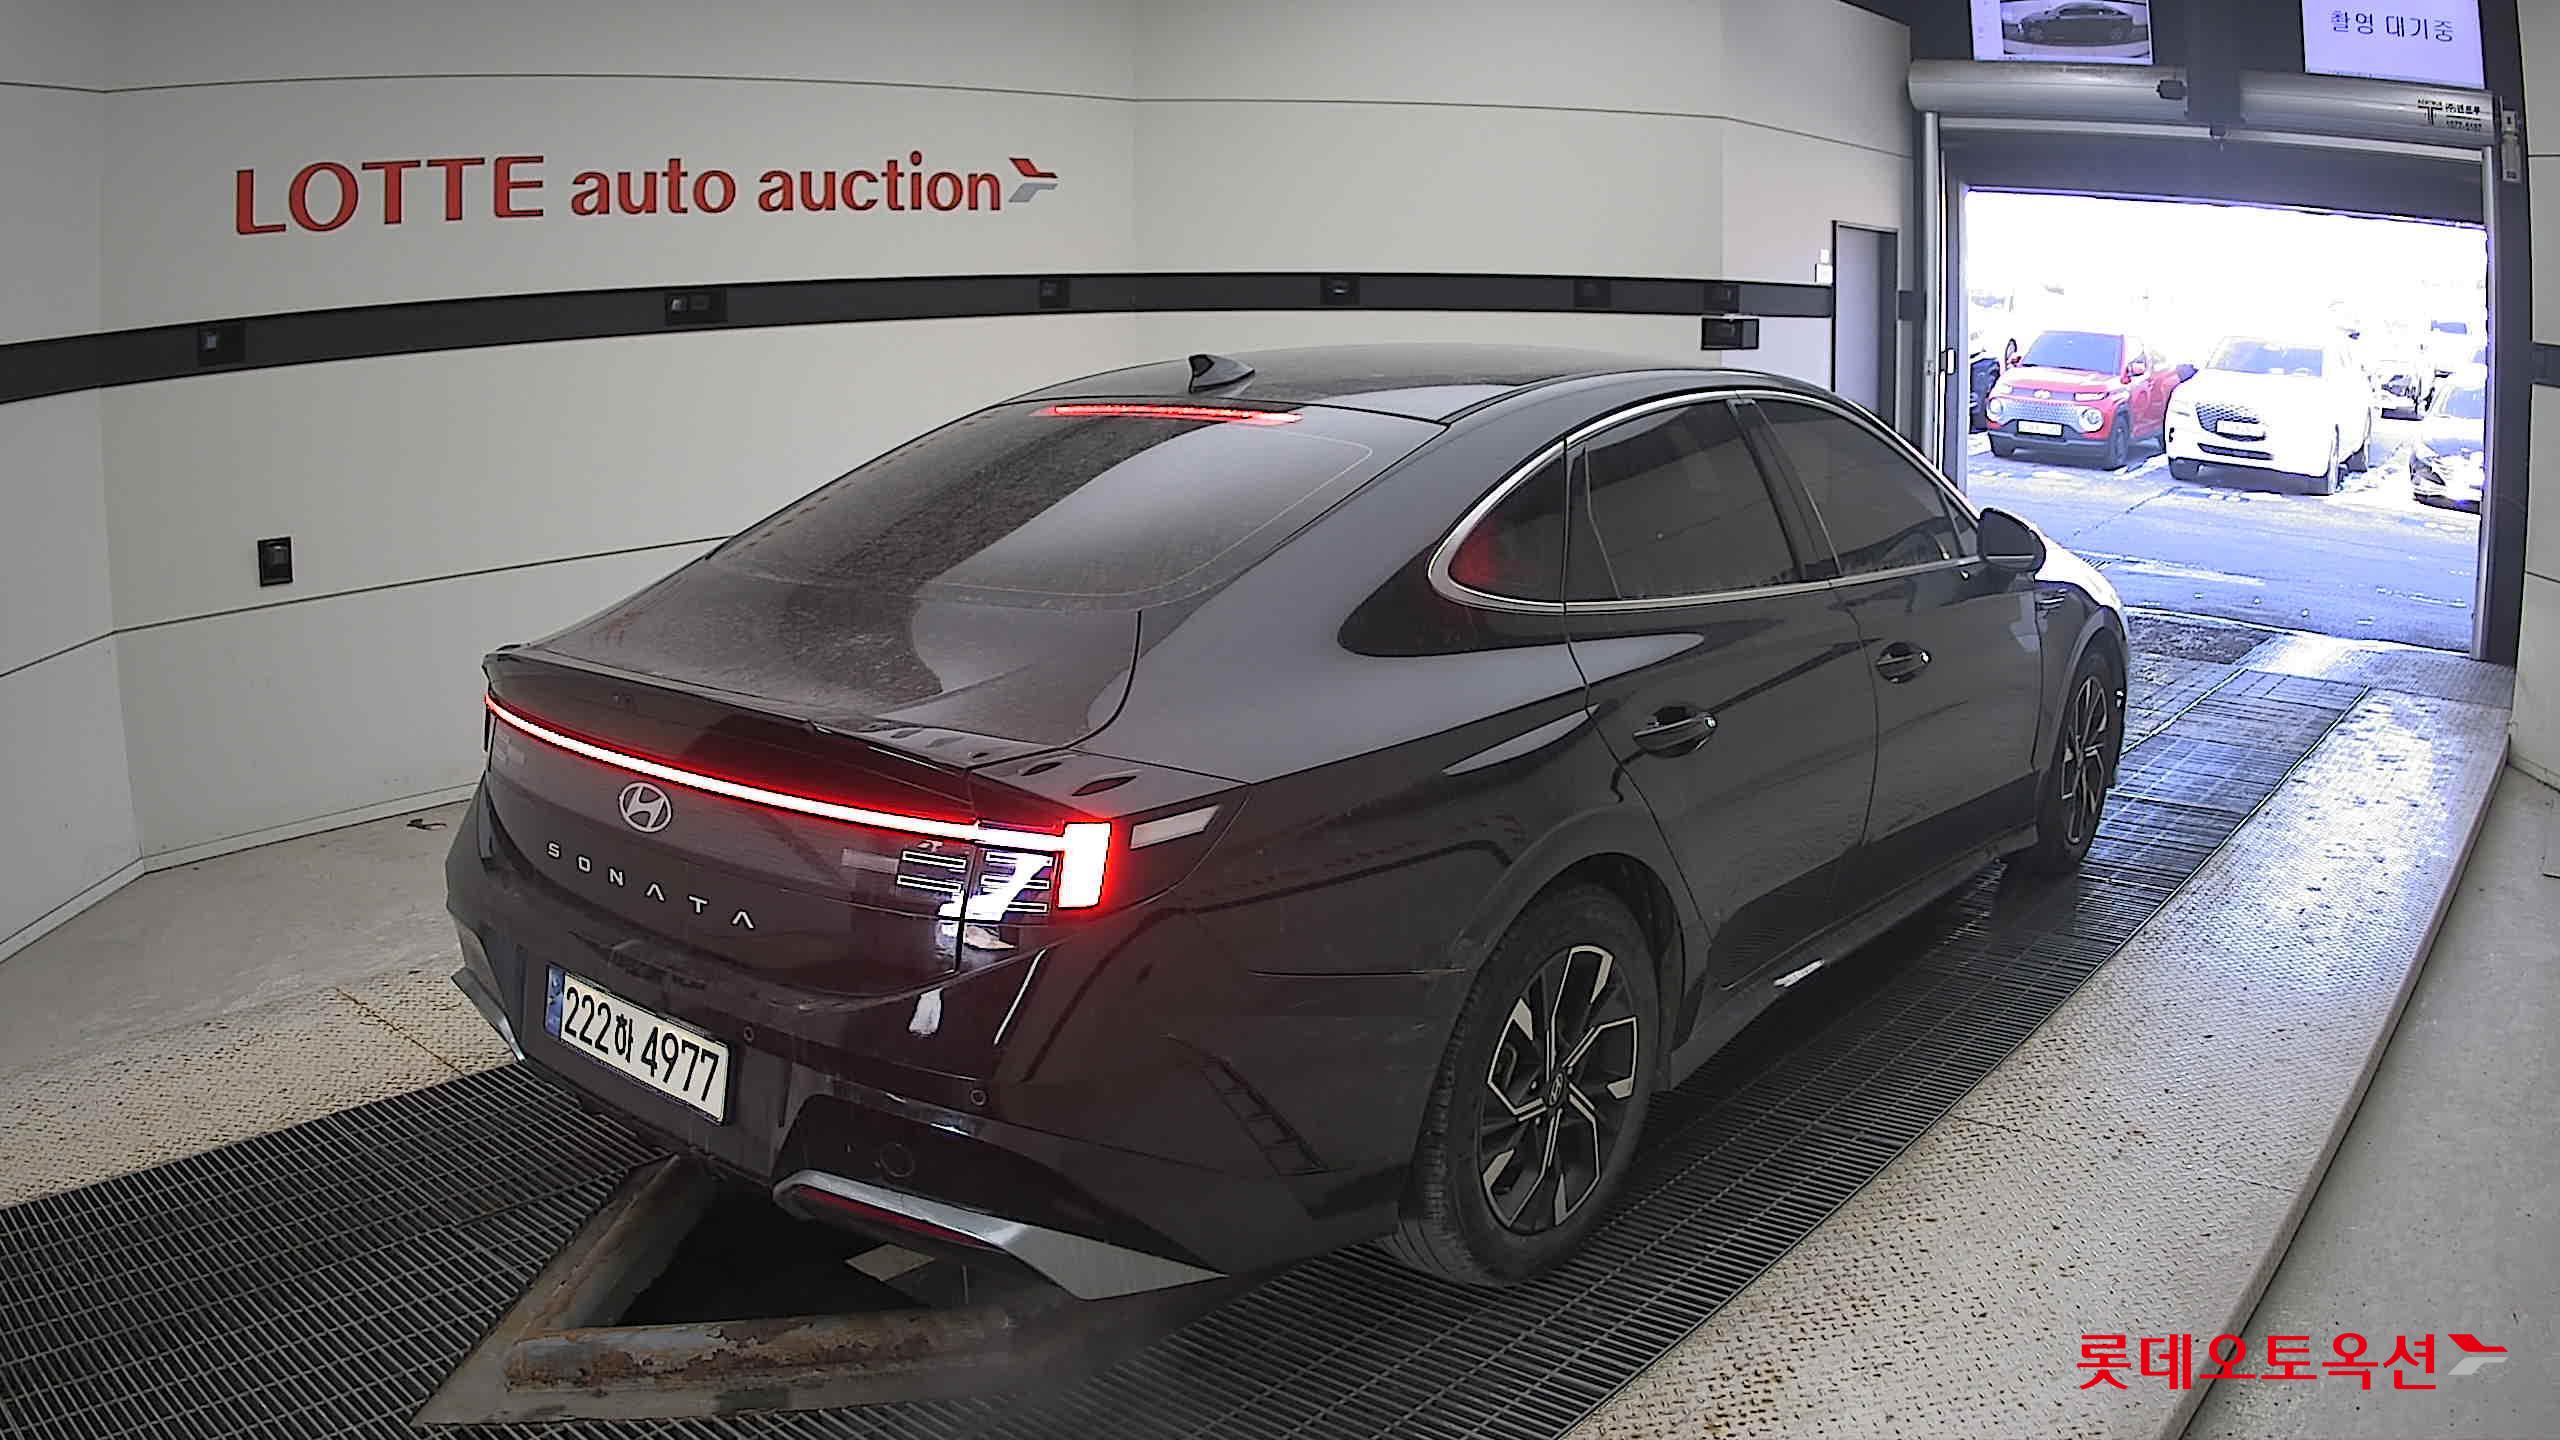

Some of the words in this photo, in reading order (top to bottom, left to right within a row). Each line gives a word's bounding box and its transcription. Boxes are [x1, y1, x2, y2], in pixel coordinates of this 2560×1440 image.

[2330, 10, 2374, 35] 촬영
[2385, 16, 2454, 42] 대기중
[236, 155, 544, 234] LOTTE
[570, 158, 737, 214] auto
[757, 150, 1002, 213] auction
[547, 842, 755, 929] SONATA
[564, 986, 634, 1063] 222하
[641, 1026, 719, 1102] 4977
